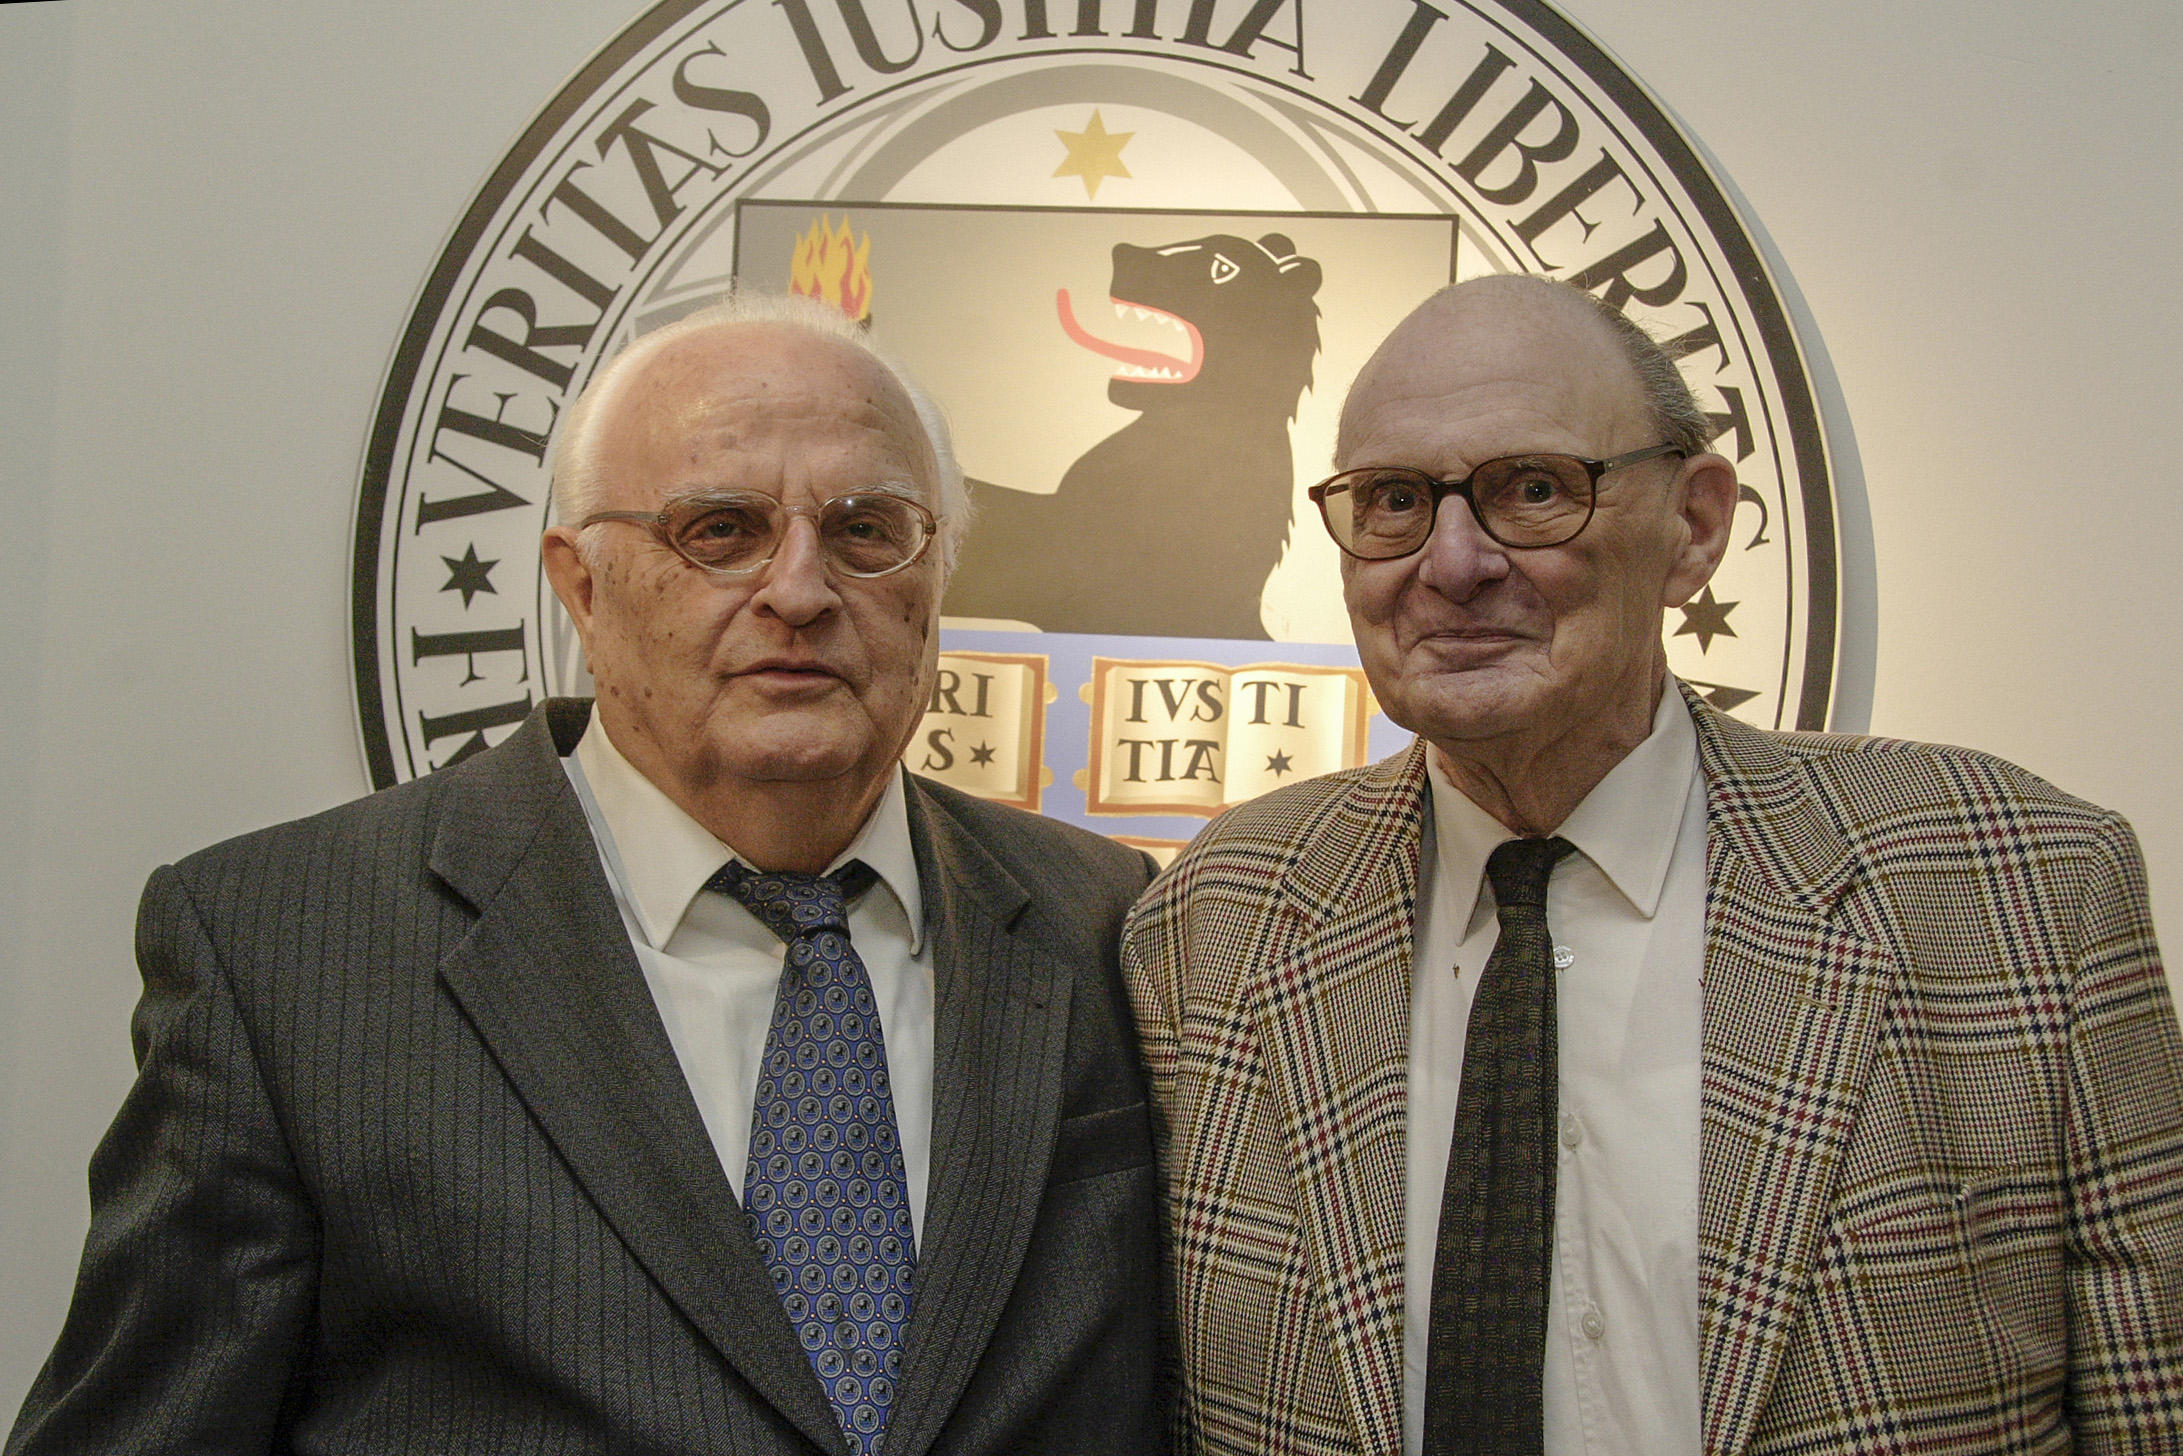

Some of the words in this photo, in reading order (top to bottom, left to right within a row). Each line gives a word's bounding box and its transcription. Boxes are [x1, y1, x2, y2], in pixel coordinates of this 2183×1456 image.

[415, 40, 771, 536] VERITAS
[1348, 0, 1771, 551] LIBERT
[1125, 679, 1224, 723] IVS
[1241, 681, 1308, 729] TI
[1117, 738, 1222, 784] TIA
